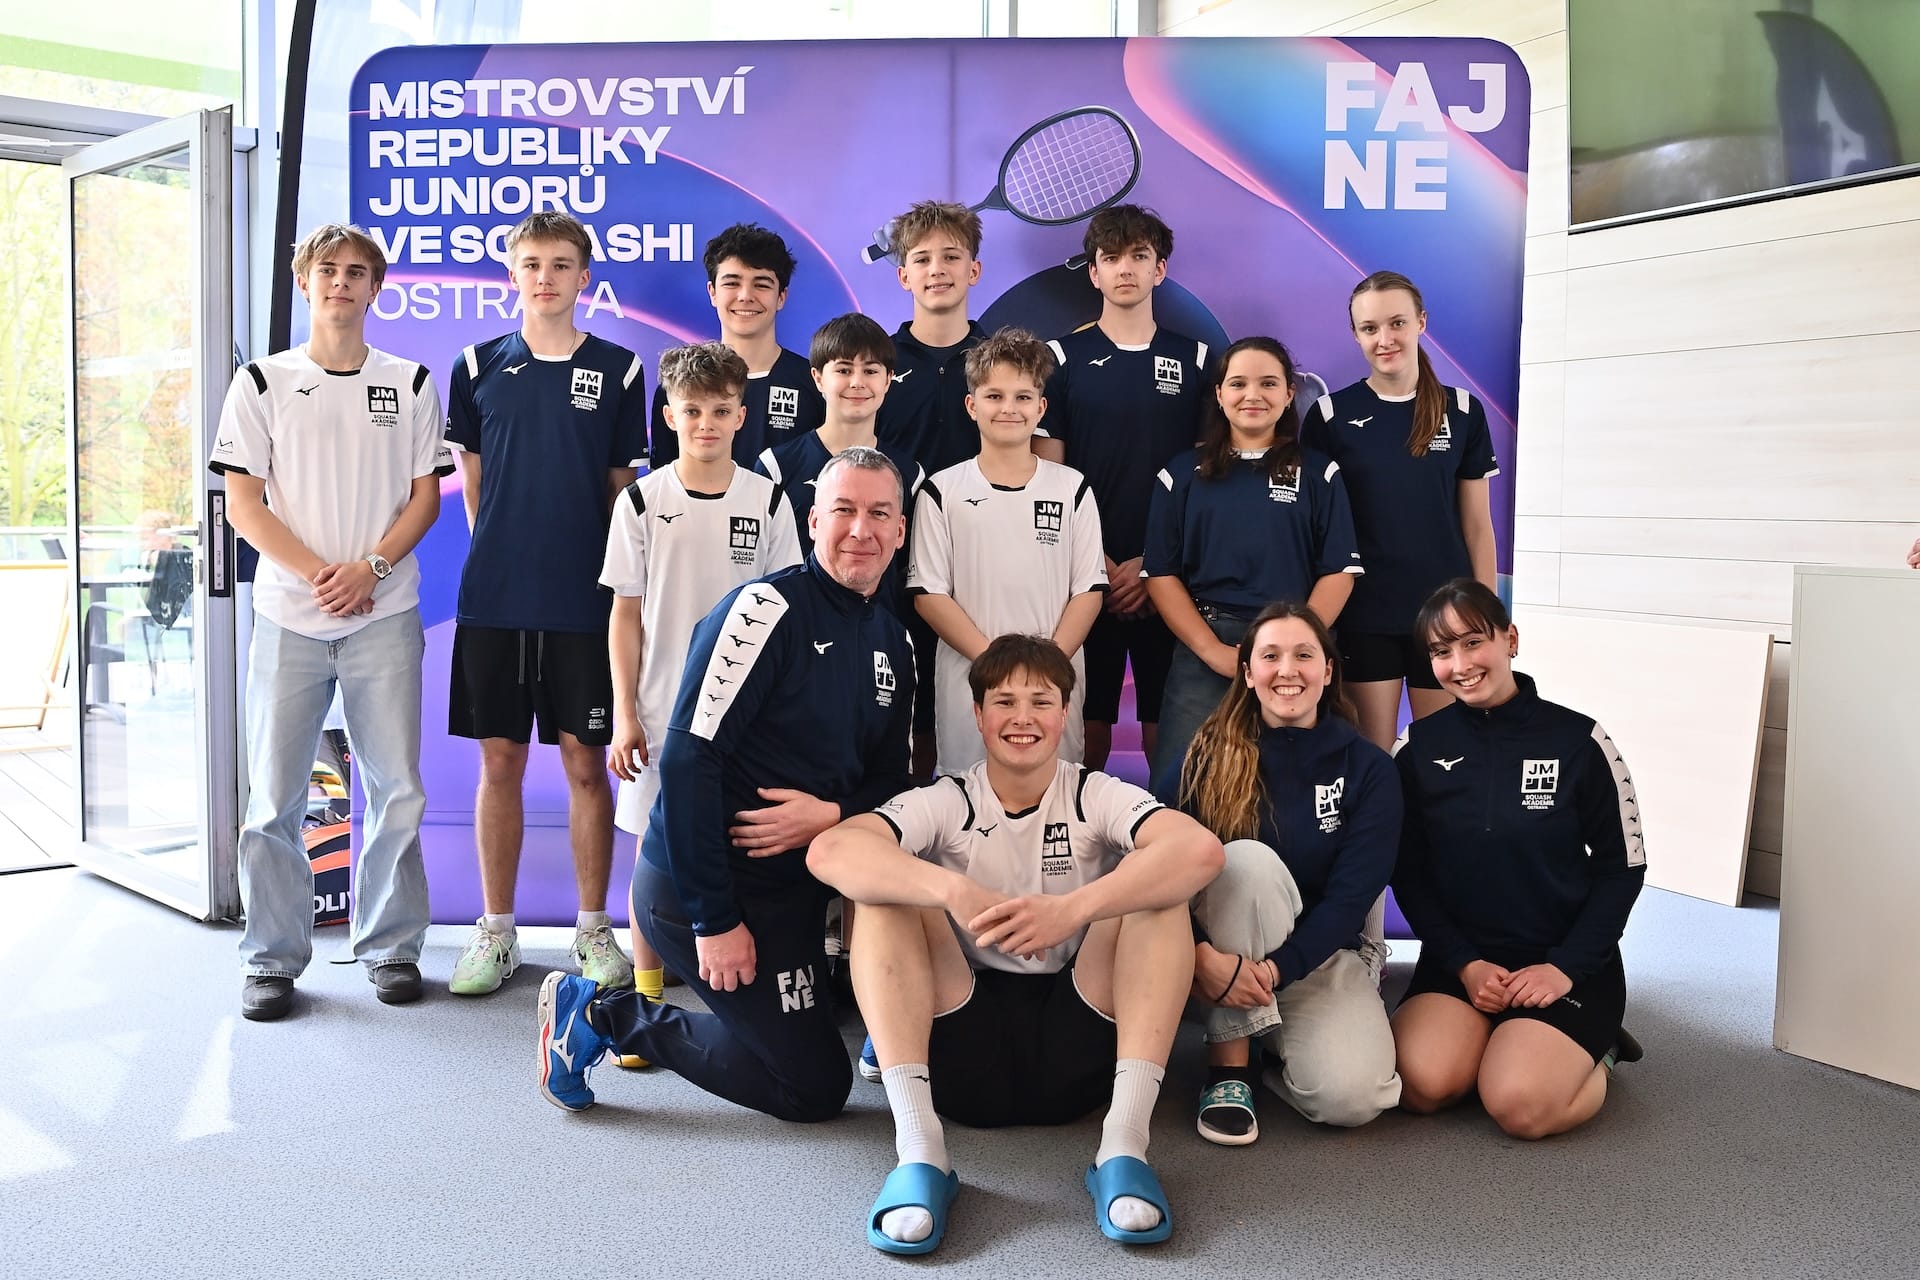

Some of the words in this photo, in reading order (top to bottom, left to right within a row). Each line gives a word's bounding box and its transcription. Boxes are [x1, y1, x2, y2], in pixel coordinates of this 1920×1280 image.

[369, 66, 756, 120] MISTROVSTVÍ
[1325, 62, 1507, 133] FAJ
[369, 126, 671, 168] REPUBLIKY
[1323, 140, 1449, 211] NE
[369, 163, 606, 216] JUNIORŮ
[369, 226, 443, 264] VE
[1160, 360, 1178, 370] JM
[577, 372, 599, 383] JM
[371, 388, 395, 400] JM
[774, 390, 794, 402] JM
[1038, 503, 1060, 515] JM
[734, 520, 757, 532] JM
[1528, 763, 1554, 775] JM
[1320, 782, 1342, 800] JM
[1046, 826, 1067, 840] JM
[781, 986, 815, 1013] NE
